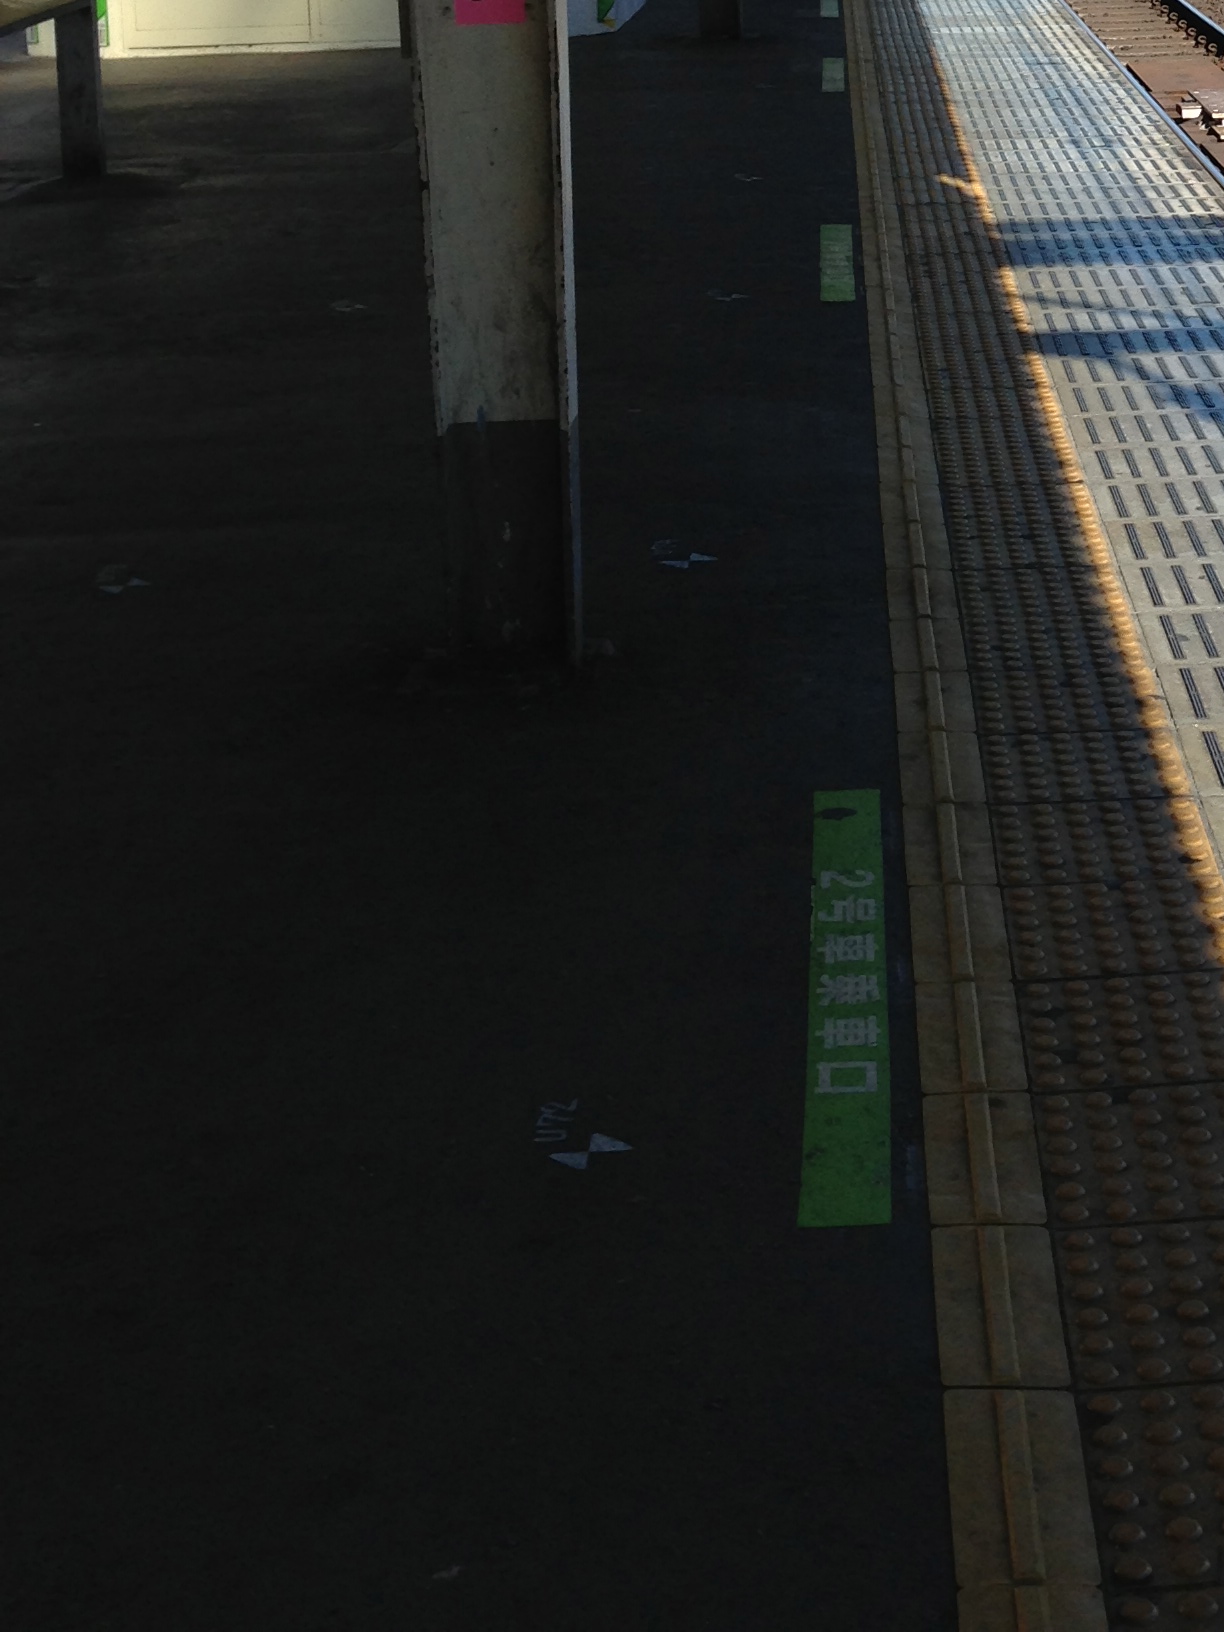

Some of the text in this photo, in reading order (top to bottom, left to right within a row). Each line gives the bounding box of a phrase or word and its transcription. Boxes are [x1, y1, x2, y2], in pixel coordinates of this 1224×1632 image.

[815, 868, 881, 1096] 2号車乗車口
